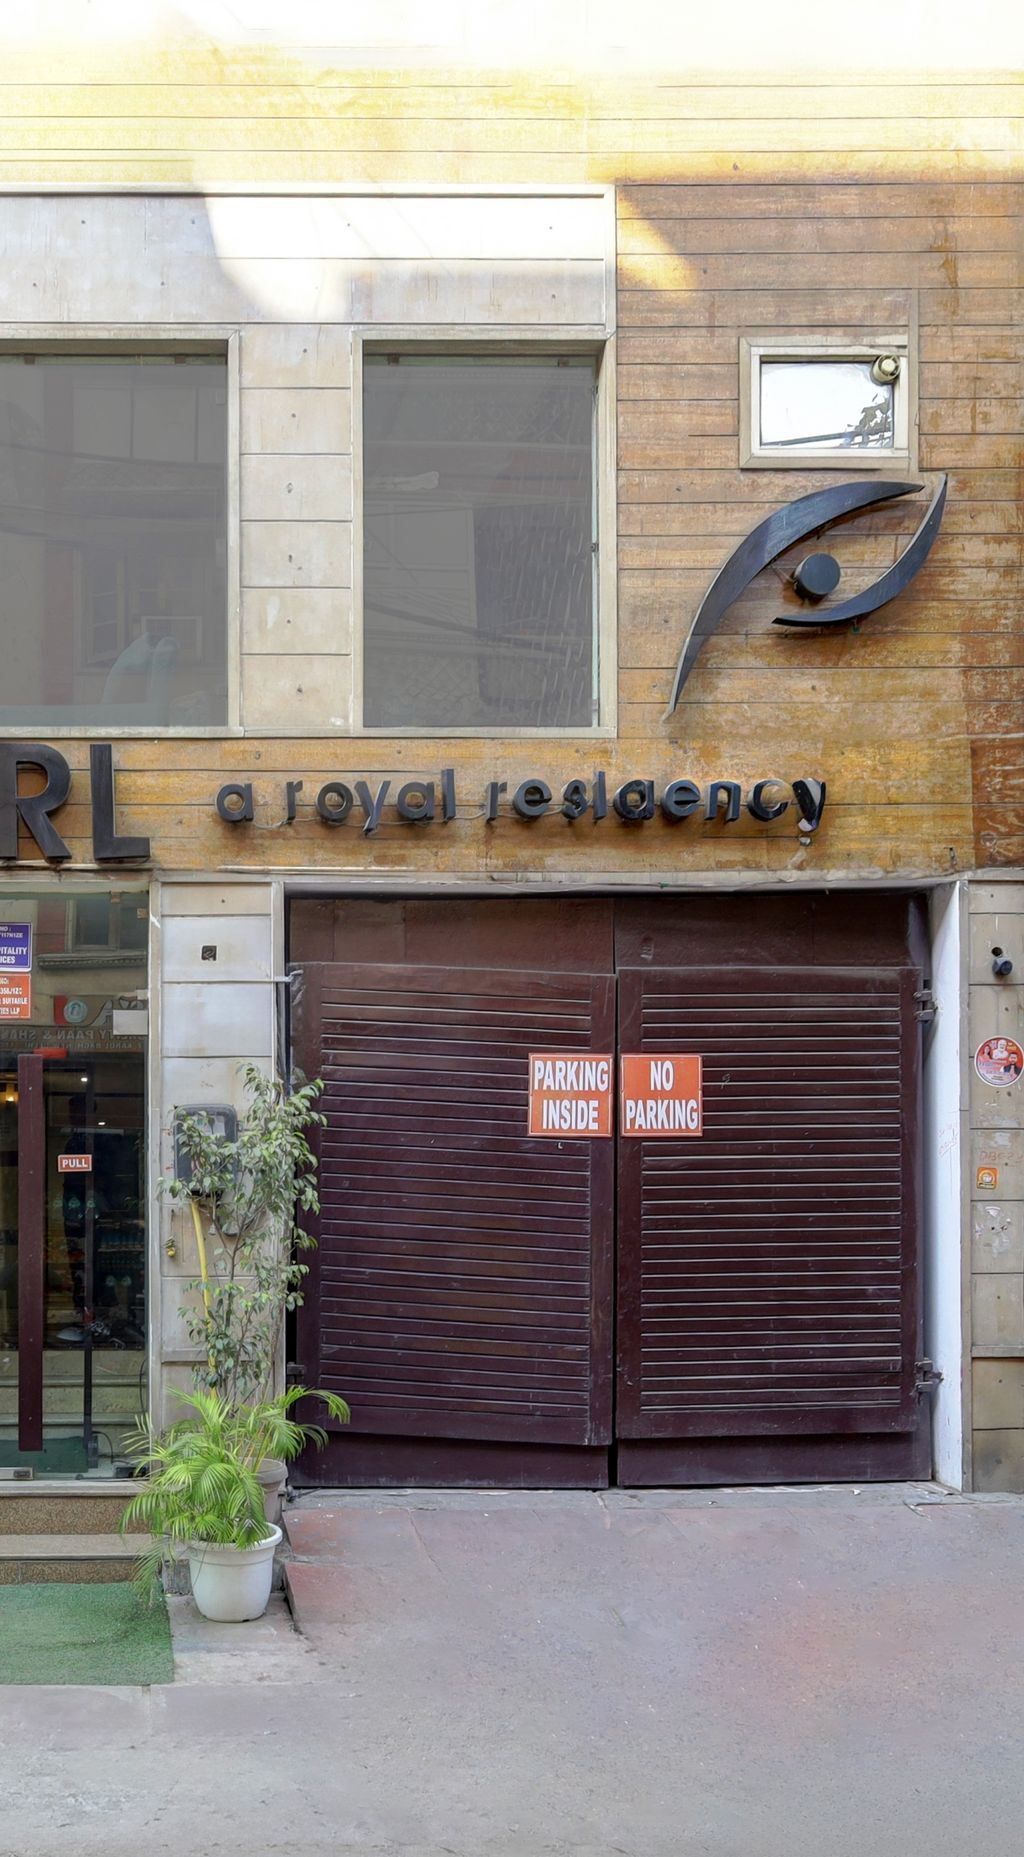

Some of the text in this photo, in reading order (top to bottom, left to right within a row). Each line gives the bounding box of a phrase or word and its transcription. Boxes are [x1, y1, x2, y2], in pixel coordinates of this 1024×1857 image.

[217, 780, 254, 823] a
[285, 768, 457, 835] royal
[534, 1060, 609, 1092] PARKING
[650, 1061, 674, 1091] NO
[542, 1099, 599, 1130] INSIDE
[626, 1099, 698, 1130] PARKING
[62, 1158, 88, 1168] PULL
